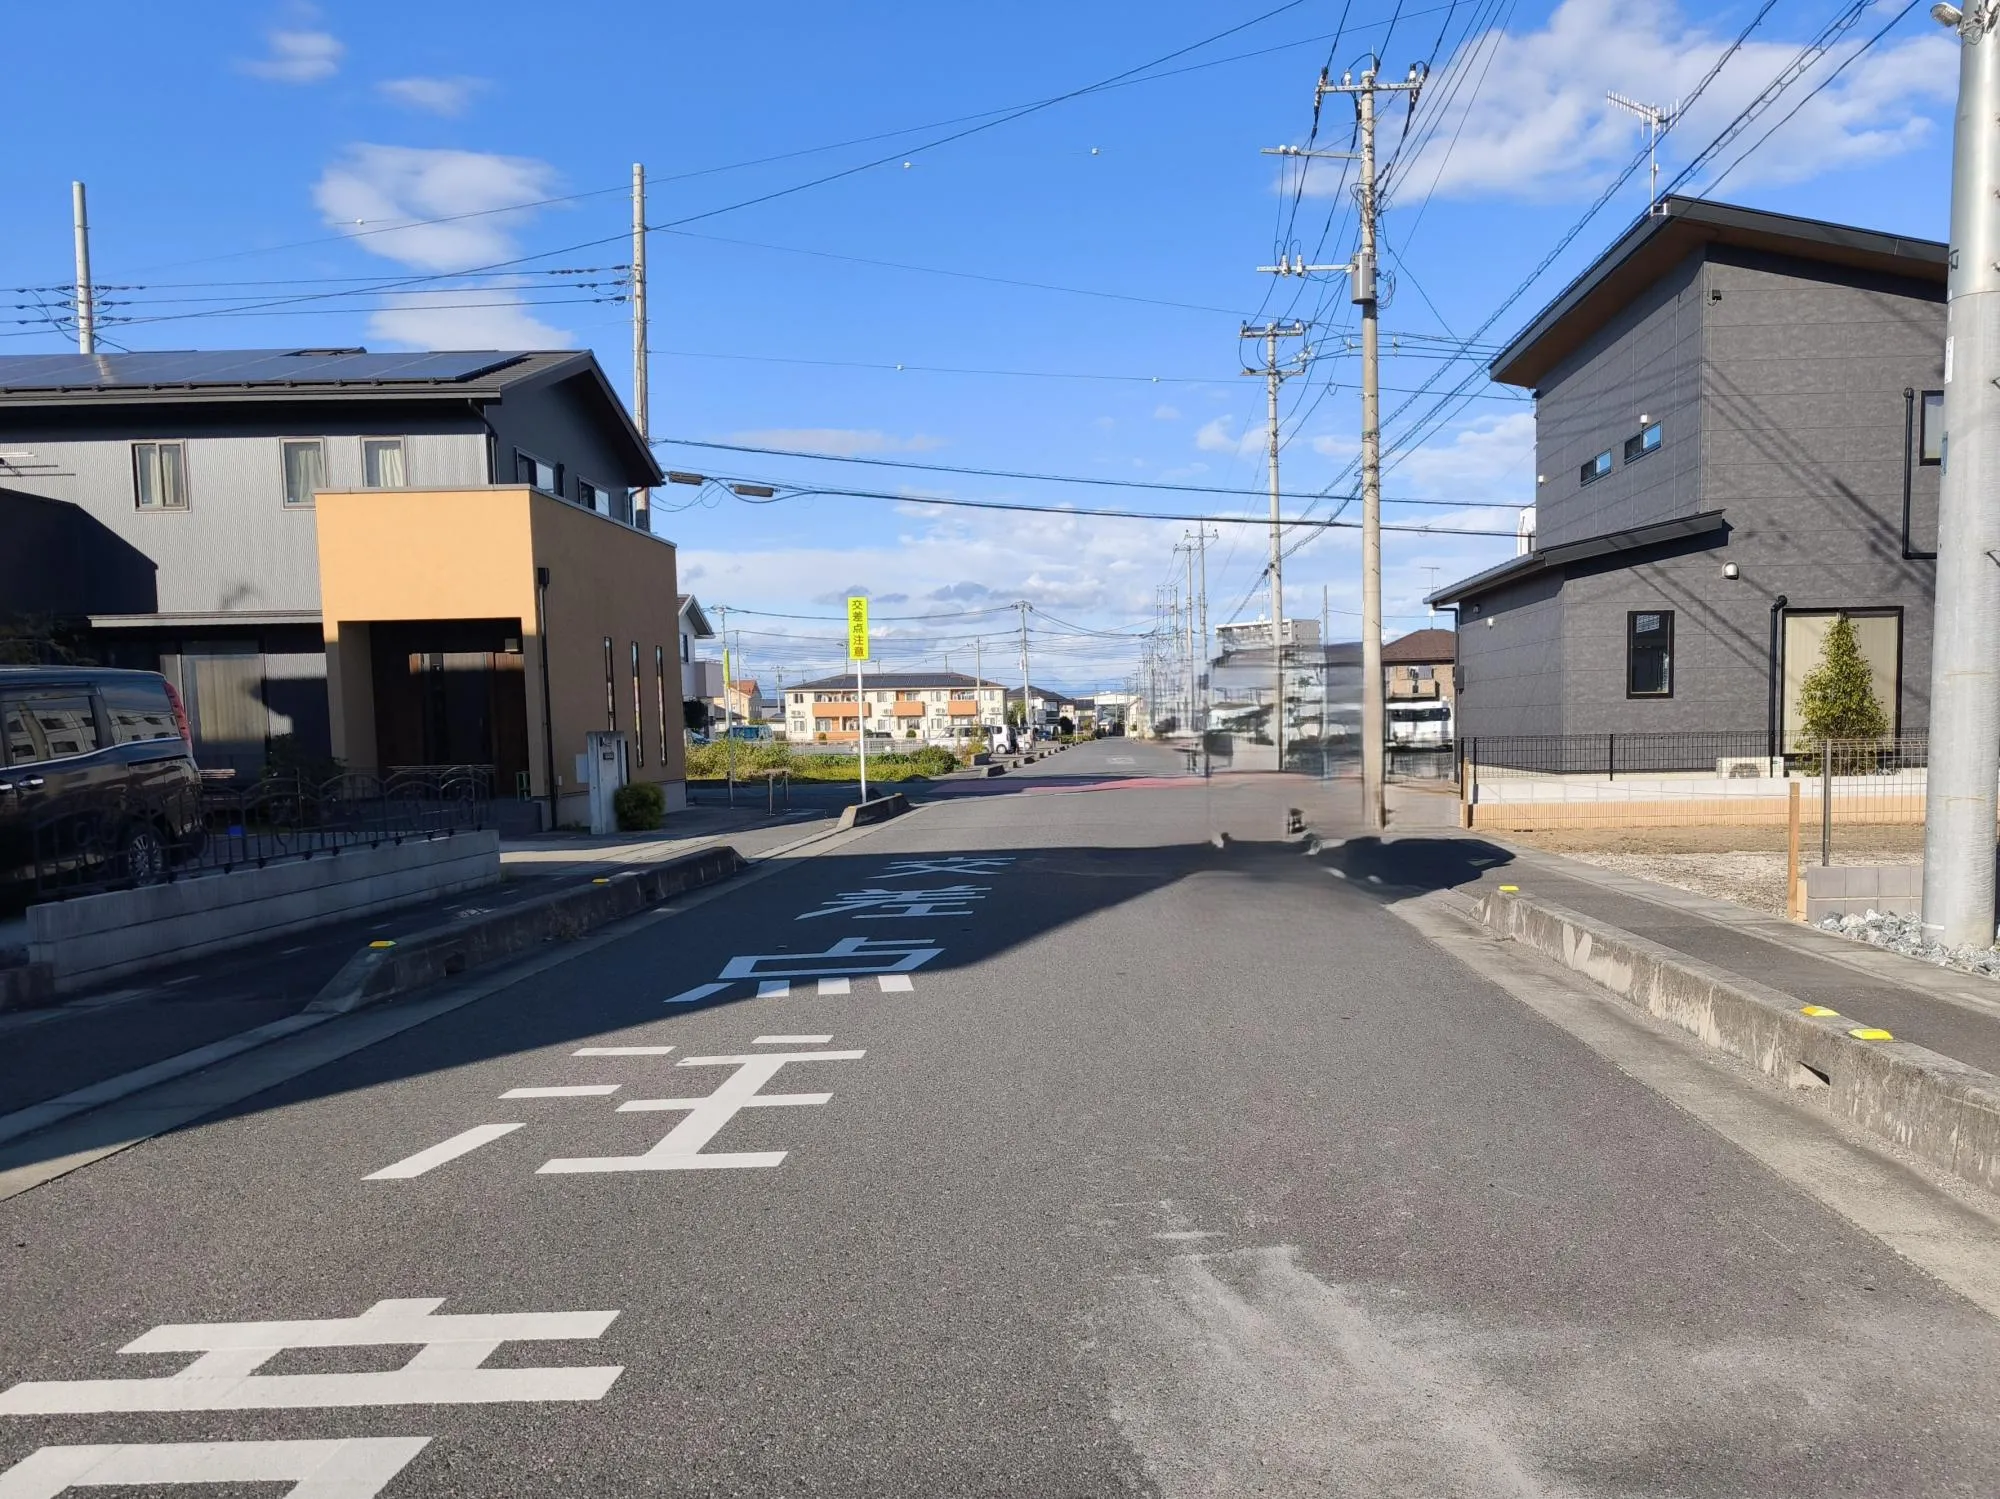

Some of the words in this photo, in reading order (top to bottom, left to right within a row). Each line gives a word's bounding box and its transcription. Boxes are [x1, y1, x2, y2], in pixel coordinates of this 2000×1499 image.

[852, 600, 864, 657] 交差点注意
